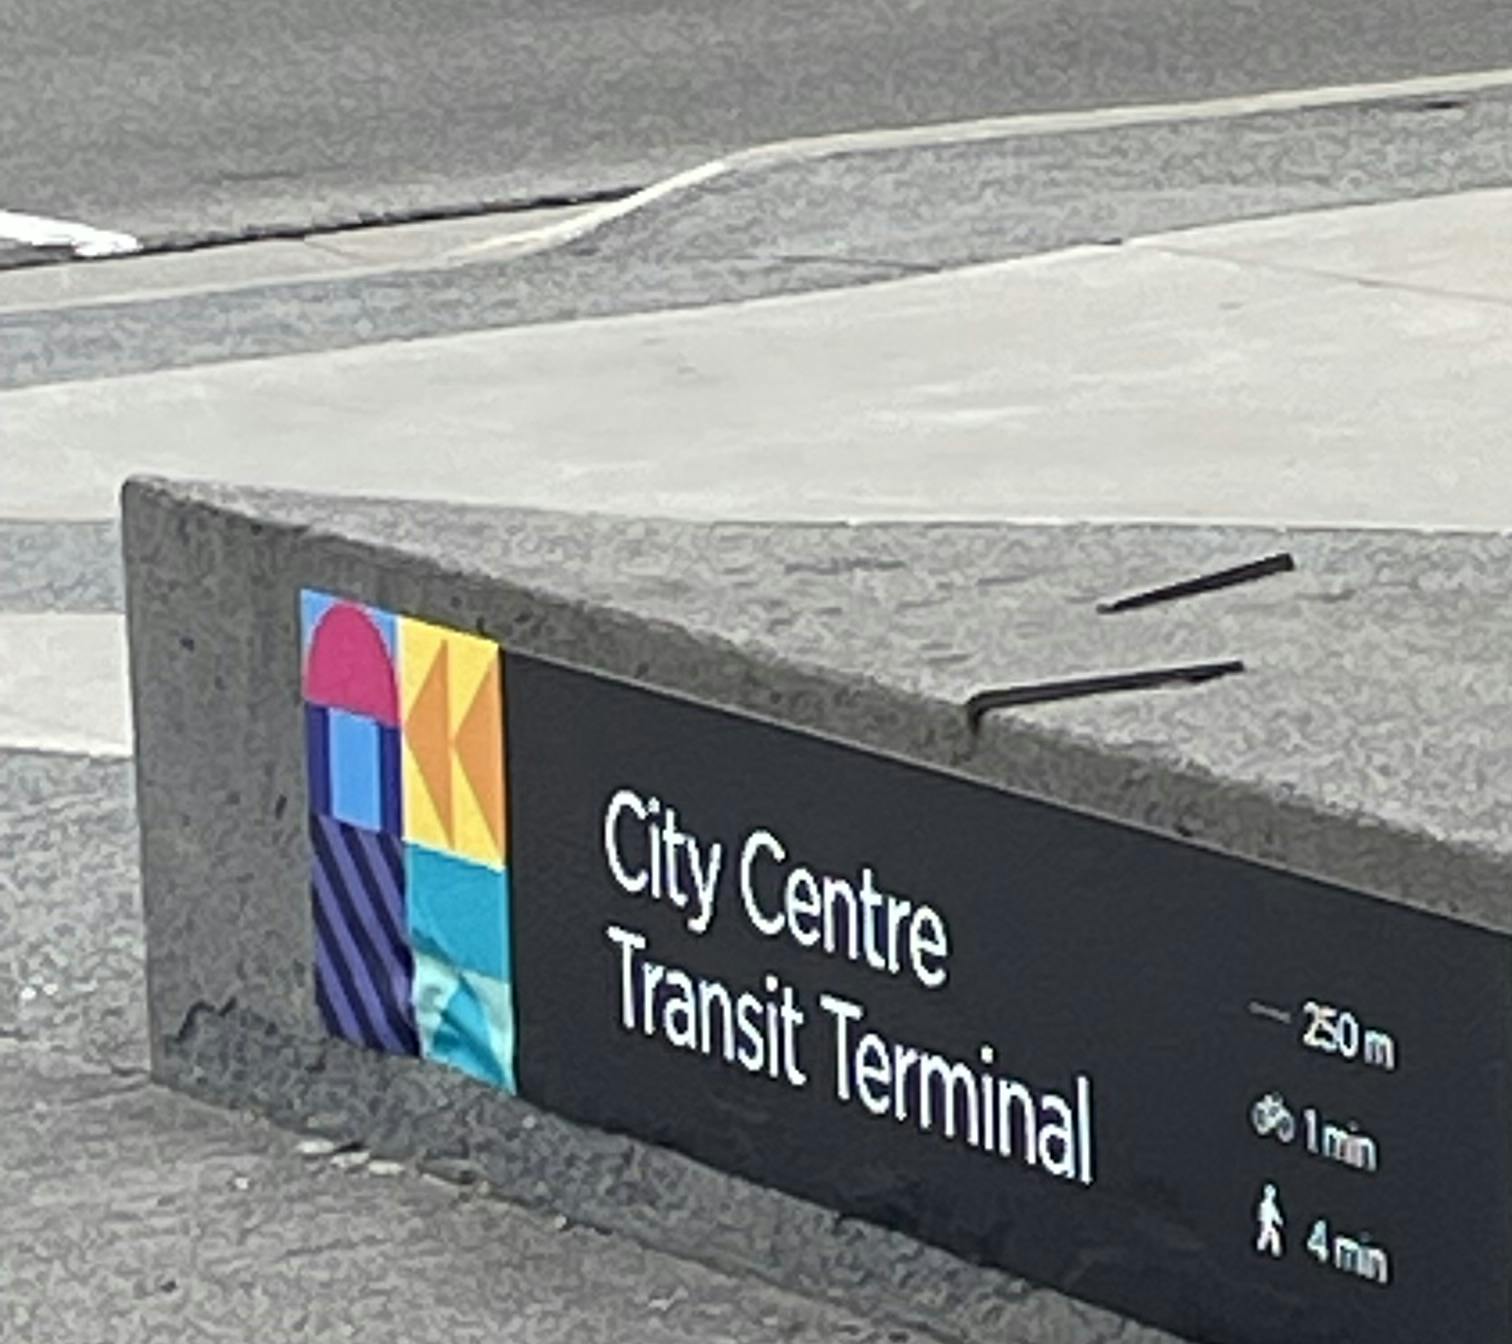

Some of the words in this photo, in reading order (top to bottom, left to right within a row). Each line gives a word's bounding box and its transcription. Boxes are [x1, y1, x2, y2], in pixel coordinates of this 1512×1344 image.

[604, 789, 721, 932] City
[739, 829, 948, 987] Centre
[606, 926, 806, 1086] Transit
[820, 994, 1094, 1185] Terminal
[1302, 1001, 1359, 1058] 250
[1364, 1030, 1396, 1071] m
[1304, 1108, 1319, 1155] 1
[1322, 1119, 1377, 1172] min
[1306, 1219, 1329, 1264] 4
[1333, 1231, 1390, 1285] min
